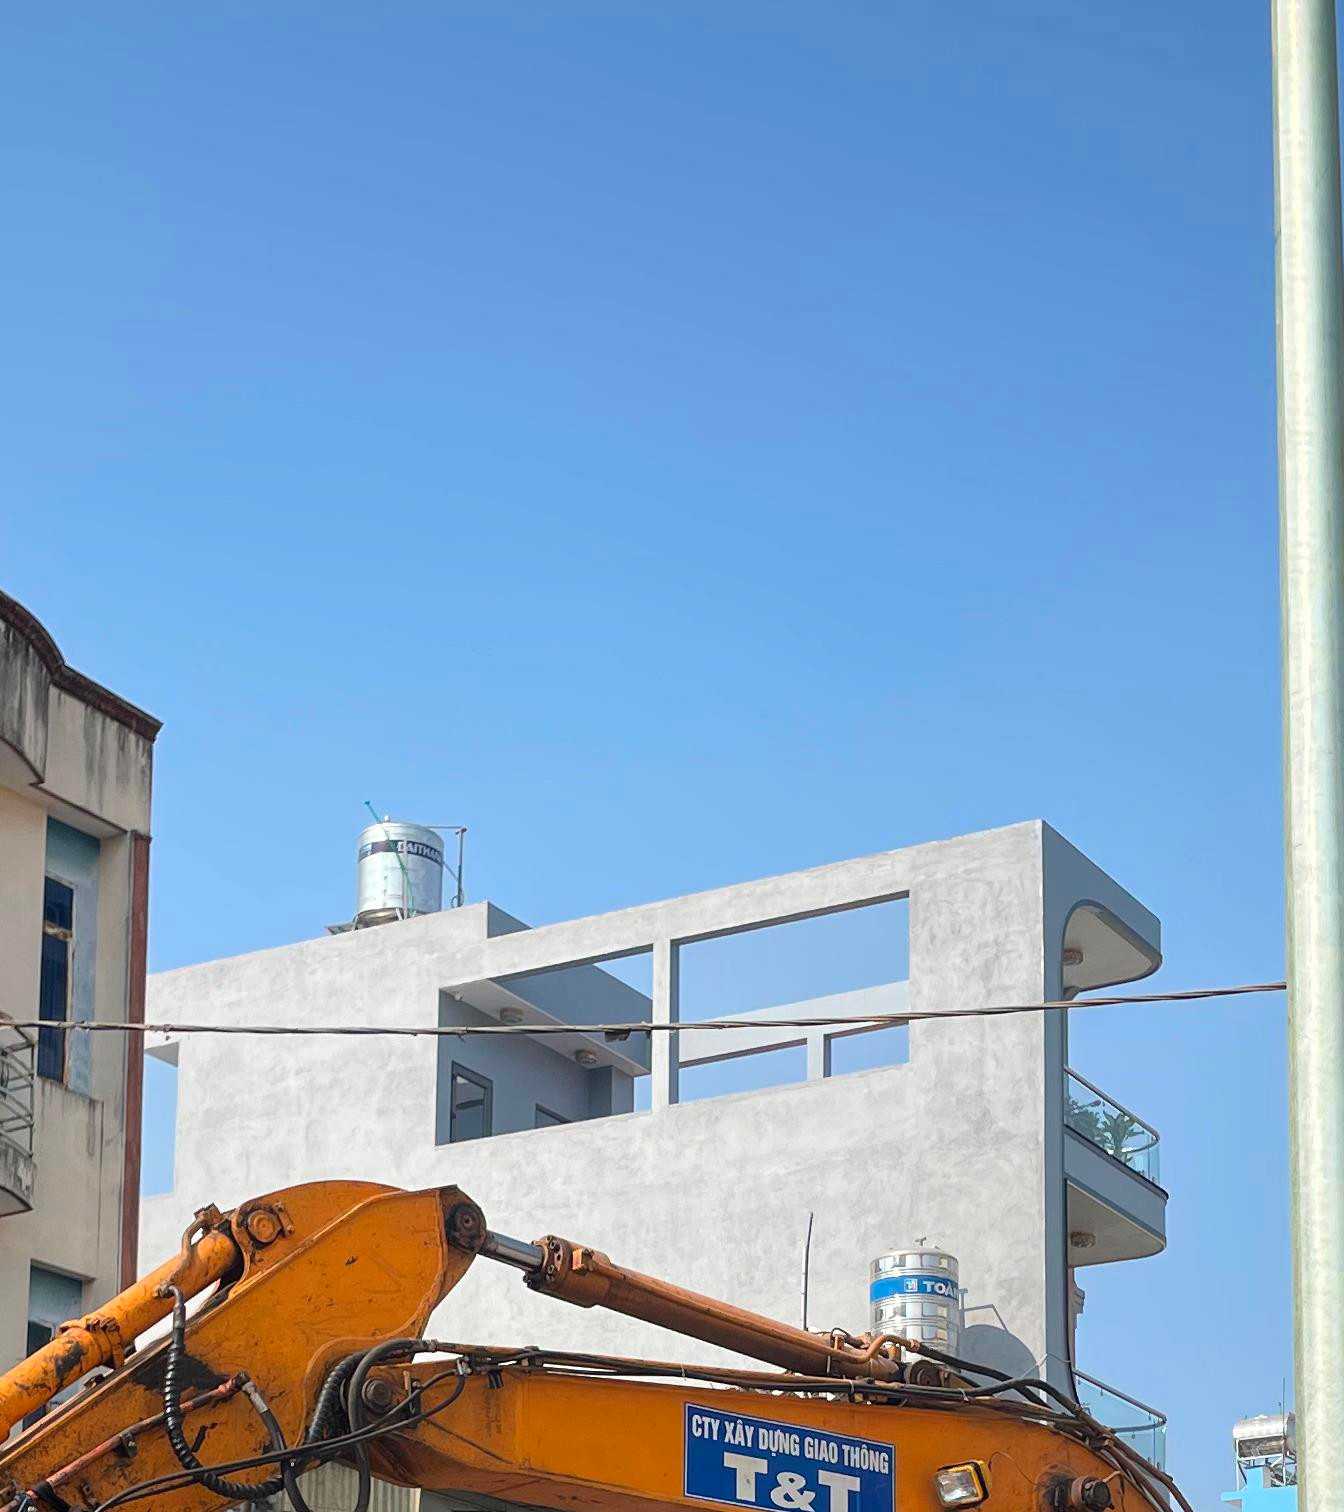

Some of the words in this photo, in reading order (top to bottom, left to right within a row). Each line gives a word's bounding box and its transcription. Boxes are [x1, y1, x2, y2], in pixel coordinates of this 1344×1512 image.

[691, 1414, 720, 1441] CTY
[724, 1419, 754, 1448] XÂY
[759, 1427, 800, 1457] DỰNG
[804, 1436, 838, 1464] GIAO
[842, 1445, 889, 1475] THÔNG
